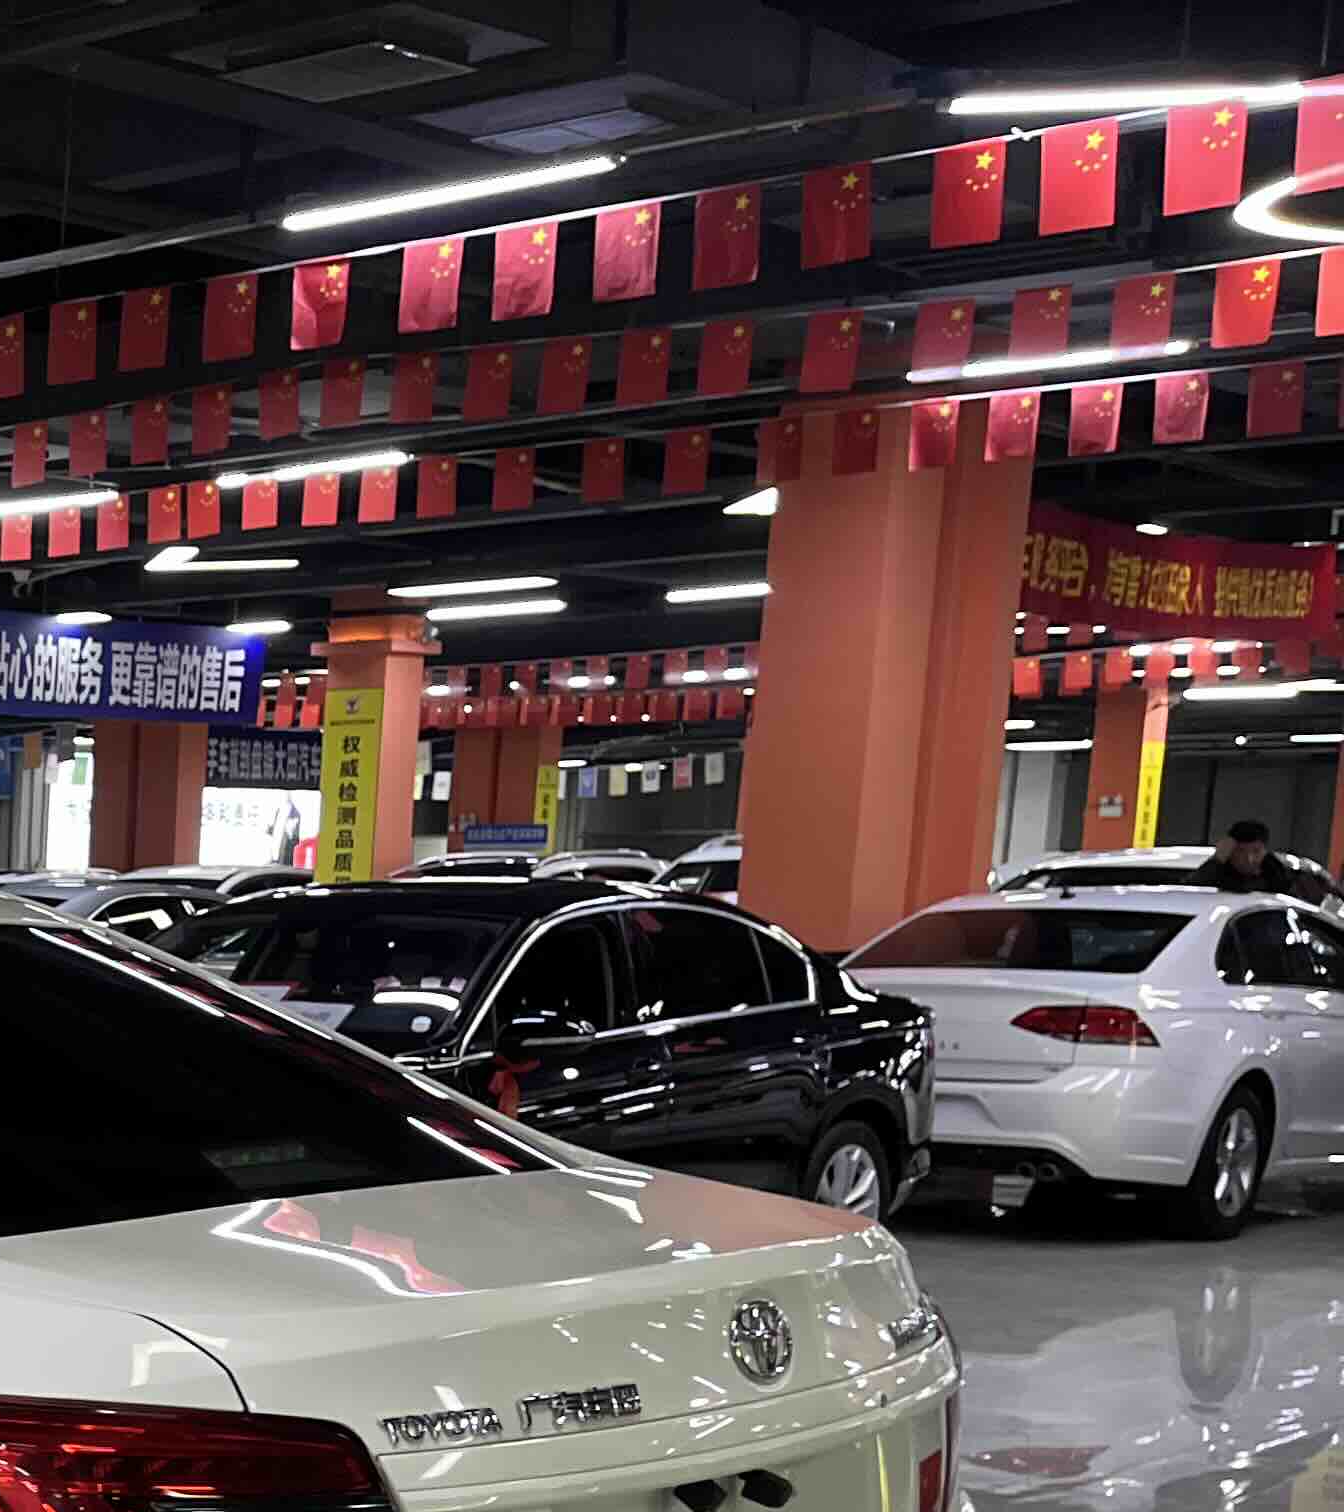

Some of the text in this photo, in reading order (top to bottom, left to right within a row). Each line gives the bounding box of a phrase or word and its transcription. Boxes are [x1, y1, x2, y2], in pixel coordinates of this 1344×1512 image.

[109, 641, 246, 712] 更靠谱的售后
[382, 1407, 503, 1444] TOYOTA
